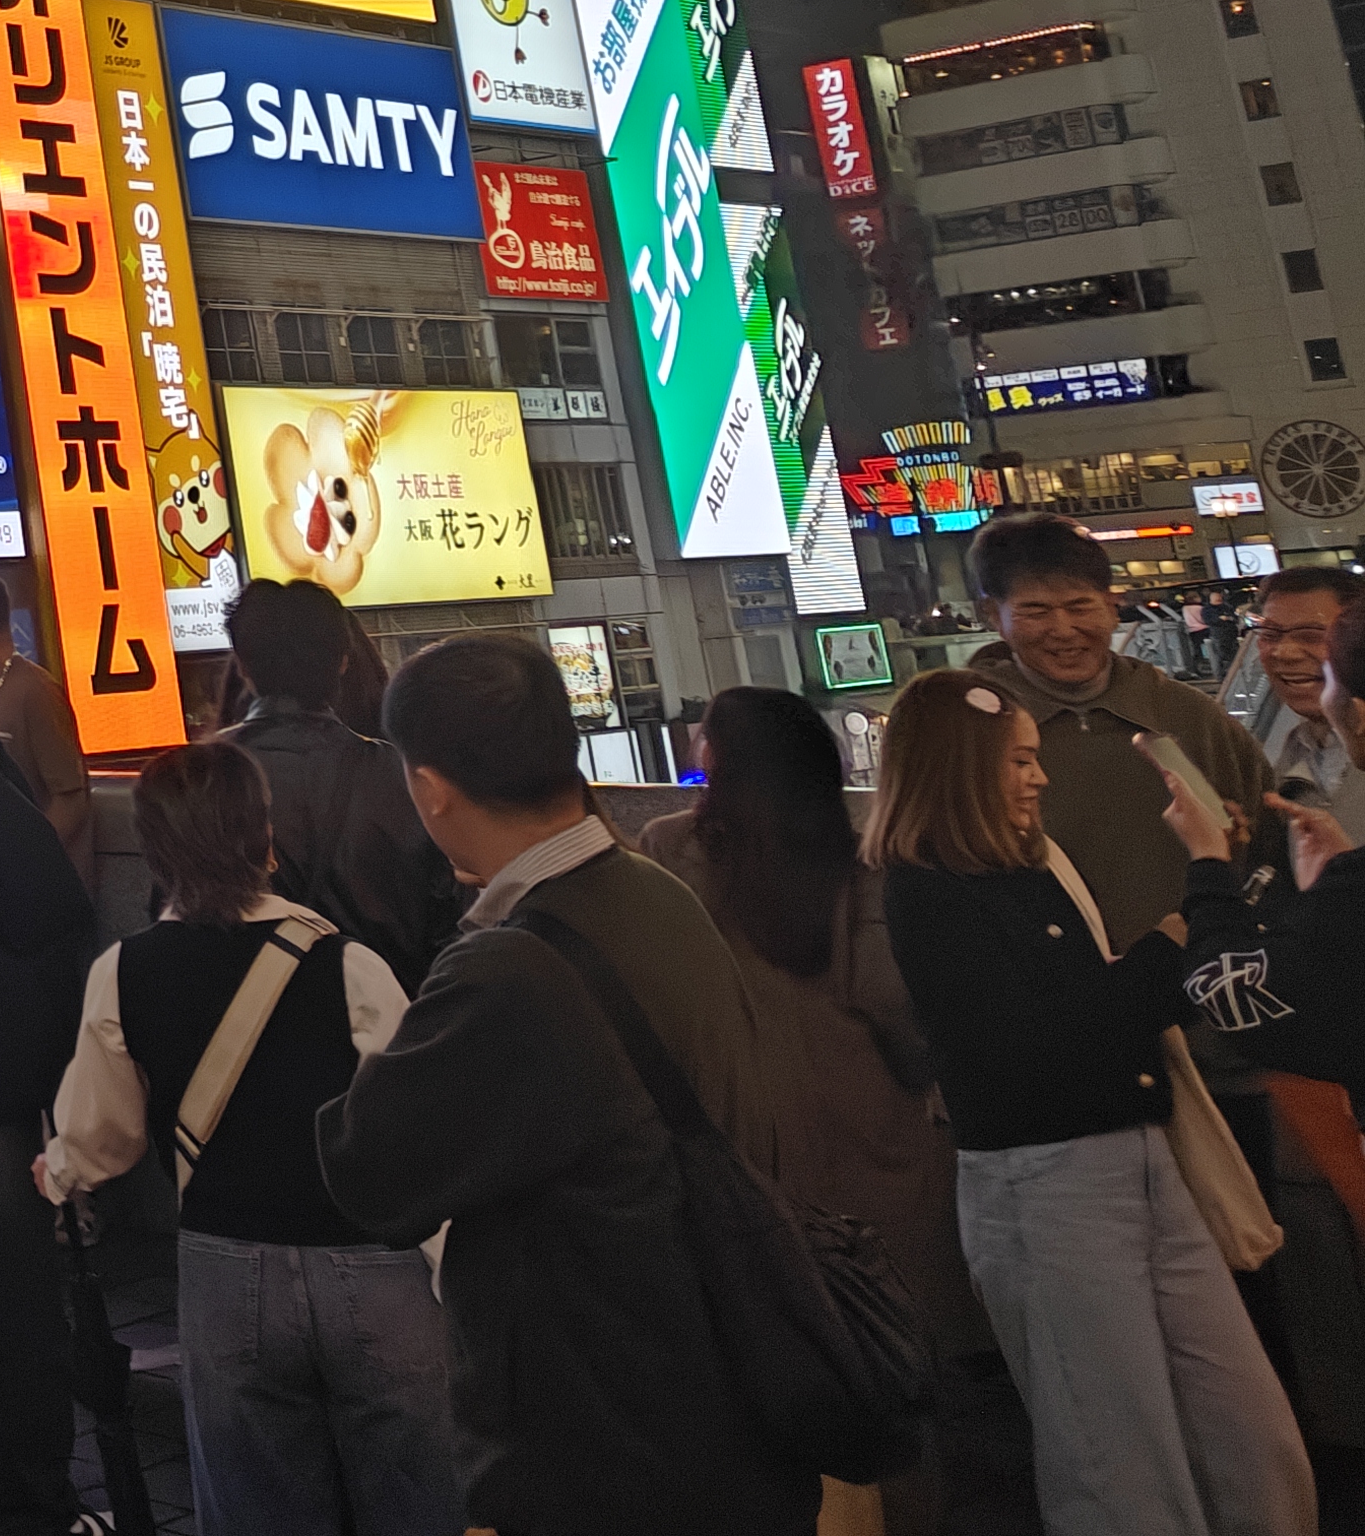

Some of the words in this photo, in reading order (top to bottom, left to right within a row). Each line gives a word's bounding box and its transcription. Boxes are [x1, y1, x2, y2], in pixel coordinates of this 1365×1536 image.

[246, 82, 457, 177] SAMTY
[493, 79, 588, 111] 日本電機産業
[815, 68, 860, 177] カラオケ
[632, 93, 711, 386] エイブル
[397, 472, 465, 501] 大阪土産
[436, 506, 534, 551] 花ラング
